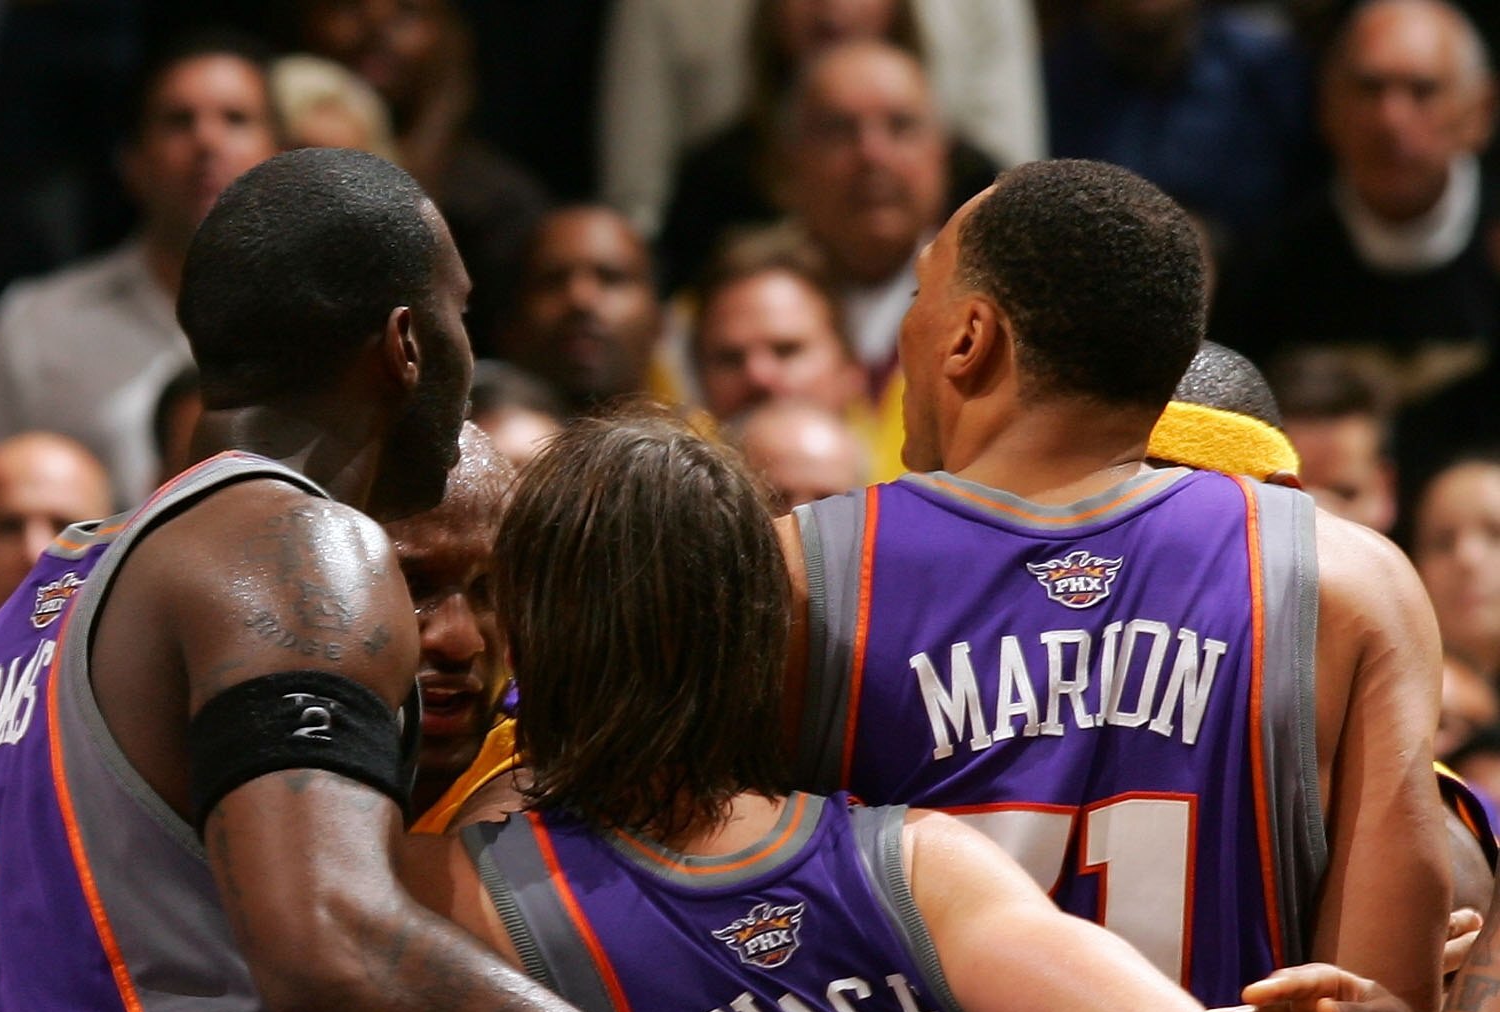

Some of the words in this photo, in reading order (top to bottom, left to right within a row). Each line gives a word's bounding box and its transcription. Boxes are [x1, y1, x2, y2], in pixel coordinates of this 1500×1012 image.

[1055, 575, 1104, 595] PHX
[909, 618, 1229, 761] MARION
[745, 927, 792, 956] PHX
